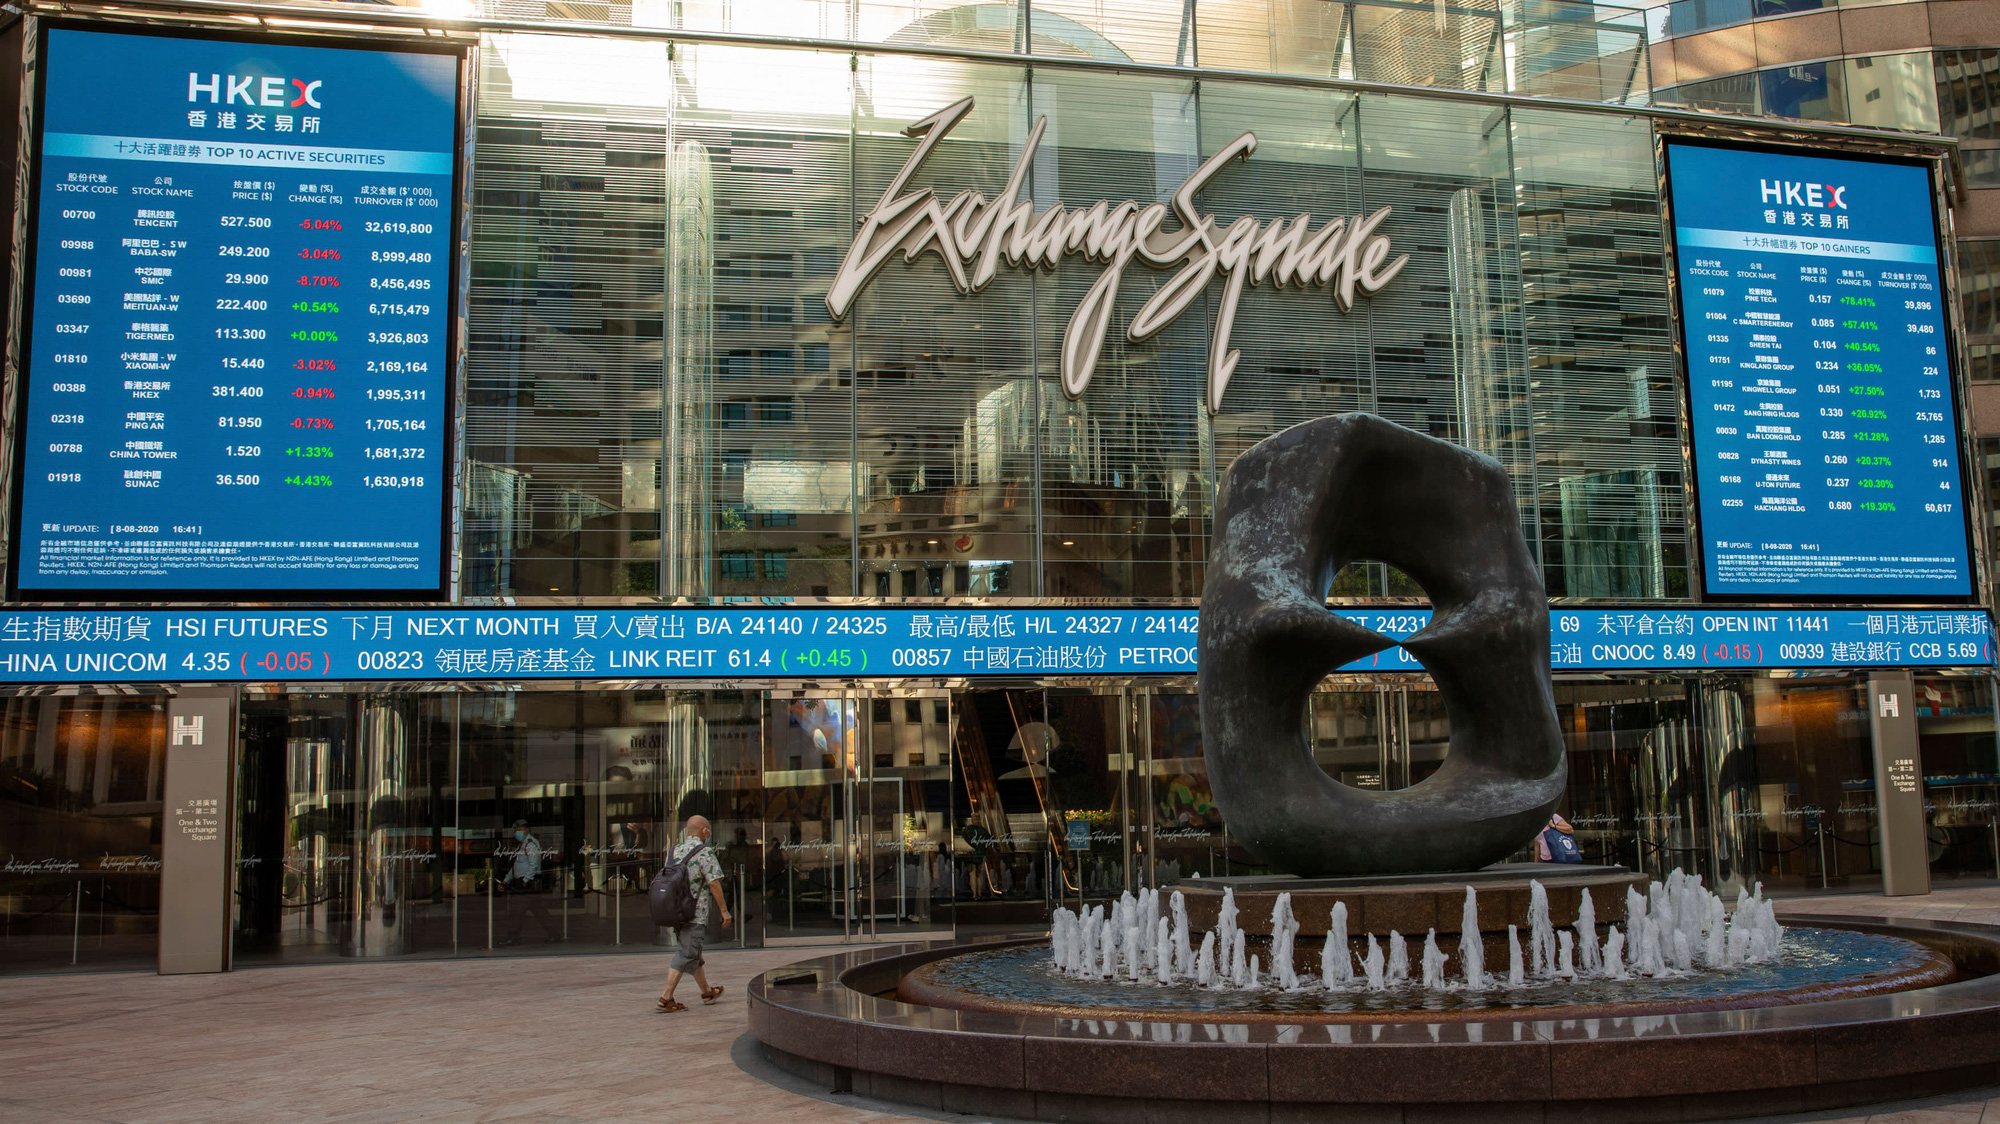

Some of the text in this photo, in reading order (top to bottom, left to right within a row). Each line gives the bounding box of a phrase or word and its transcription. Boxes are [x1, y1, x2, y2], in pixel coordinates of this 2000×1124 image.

[188, 72, 322, 108] HKEX
[188, 110, 320, 133] 香港交易所
[114, 141, 385, 165] 十大活躍證券 TOP 10 ACTIVE SECURITIES
[154, 177, 172, 186] 公司
[56, 184, 88, 192] STOCK
[132, 187, 162, 195] STOCK
[289, 195, 326, 203] CHANGE
[1761, 179, 1847, 209] HKEX
[354, 197, 402, 205] TURNOVER
[63, 210, 95, 219] 00700
[1764, 210, 1848, 229] 香港交易所
[134, 219, 178, 227] TENCENT
[221, 216, 270, 227] 527.500
[299, 219, 342, 231] -5.04%
[365, 222, 432, 234] 32,619,800
[61, 240, 93, 249] 09988
[1800, 242, 1817, 250] TOP
[1821, 243, 1831, 251] 10
[1833, 244, 1871, 254] GAINERS
[130, 248, 176, 256] BABA-SW
[219, 246, 269, 257] 249.200
[298, 248, 340, 260] -3.04%
[826, 95, 1409, 415] Exchange Square
[372, 251, 431, 264] 8,999,480
[59, 268, 90, 277] 00981
[226, 274, 268, 284] 29.900
[297, 276, 340, 287] -8.70%
[370, 278, 430, 290] 8,456,495
[58, 295, 90, 304] 03690
[1810, 294, 1831, 303] 0.157
[124, 303, 178, 311] MEITUAN-W
[216, 299, 266, 310] 222.400
[292, 302, 339, 313] +0.54%
[1905, 301, 1931, 310] 39,896
[369, 304, 429, 316] 6,715,479
[1812, 318, 1834, 327] 0.085
[56, 324, 88, 333] 03347
[216, 328, 265, 339] 113.300
[1908, 324, 1933, 333] 39,480
[126, 332, 174, 340] TIGERMED
[291, 330, 338, 342] +0.00%
[368, 332, 428, 344] 3,926,803
[1814, 340, 1836, 349] 0.104
[55, 354, 87, 363] 01810
[222, 358, 264, 368] 15.440
[126, 362, 170, 370] XIAOMI-W
[293, 359, 336, 370] -3.02%
[367, 361, 427, 373] 2,169,164
[1816, 361, 1838, 370] 0.234
[53, 383, 85, 392] 00388
[212, 386, 262, 396] 381.400
[1818, 384, 1840, 393] 0.051
[292, 388, 335, 398] -0.94%
[367, 389, 425, 401] 1,995,311
[1919, 390, 1940, 398] 1,733
[1820, 408, 1843, 416] 0.330
[1916, 412, 1943, 421] 25,765
[51, 415, 83, 423] 02318
[218, 417, 261, 427] 81.950
[290, 418, 334, 429] -0.73%
[366, 420, 425, 431] 1,705,164
[1823, 431, 1845, 439] 0.285
[1924, 435, 1945, 444] 1,285
[50, 444, 82, 452] 00788
[226, 446, 260, 456] 1.520
[286, 446, 334, 458] +1.33%
[365, 448, 424, 460] 1,681,372
[1825, 455, 1848, 464] 0.260
[48, 473, 80, 482] 01918
[216, 475, 259, 485] 36.500
[285, 475, 332, 487] +4.43%
[364, 476, 423, 488] 1,630,918
[1827, 478, 1849, 486] 0.237
[1829, 501, 1852, 510] 0.680
[1926, 504, 1951, 512] 60,617
[1, 616, 151, 642] 生指數期貨
[167, 618, 205, 636] HSI
[215, 618, 327, 636] FUTURES
[342, 616, 392, 640] 下月
[408, 618, 469, 635] NEXT
[476, 618, 558, 635] MONTH
[573, 615, 684, 639] 買入/賣出
[697, 618, 732, 634] B/A
[741, 617, 802, 634] 24140
[826, 617, 887, 634] 24325
[910, 614, 1015, 638] 最高/最低
[1026, 617, 1057, 633] H/L
[1066, 617, 1122, 633] 24327
[1598, 614, 1693, 635] 未平倉合約
[1703, 616, 1748, 632] OPEN
[1753, 617, 1778, 631] INT
[1787, 617, 1828, 631] 11441
[66, 653, 166, 672] UNICOM
[182, 652, 230, 670] 4.35
[358, 651, 423, 670] 00823
[435, 648, 595, 672] 領展房產基金
[610, 650, 659, 667] LINK
[667, 650, 716, 667] REIT
[729, 649, 771, 667] 61.4
[892, 649, 951, 666] 00857
[964, 646, 1106, 669] 中國石油股份
[1592, 644, 1654, 660] CNOOC
[1664, 644, 1696, 660] 8.49
[1780, 644, 1824, 659] 00939
[1831, 642, 1902, 661] 建設銀行
[1910, 643, 1942, 658] CCB
[1948, 643, 1977, 657] 5.69
